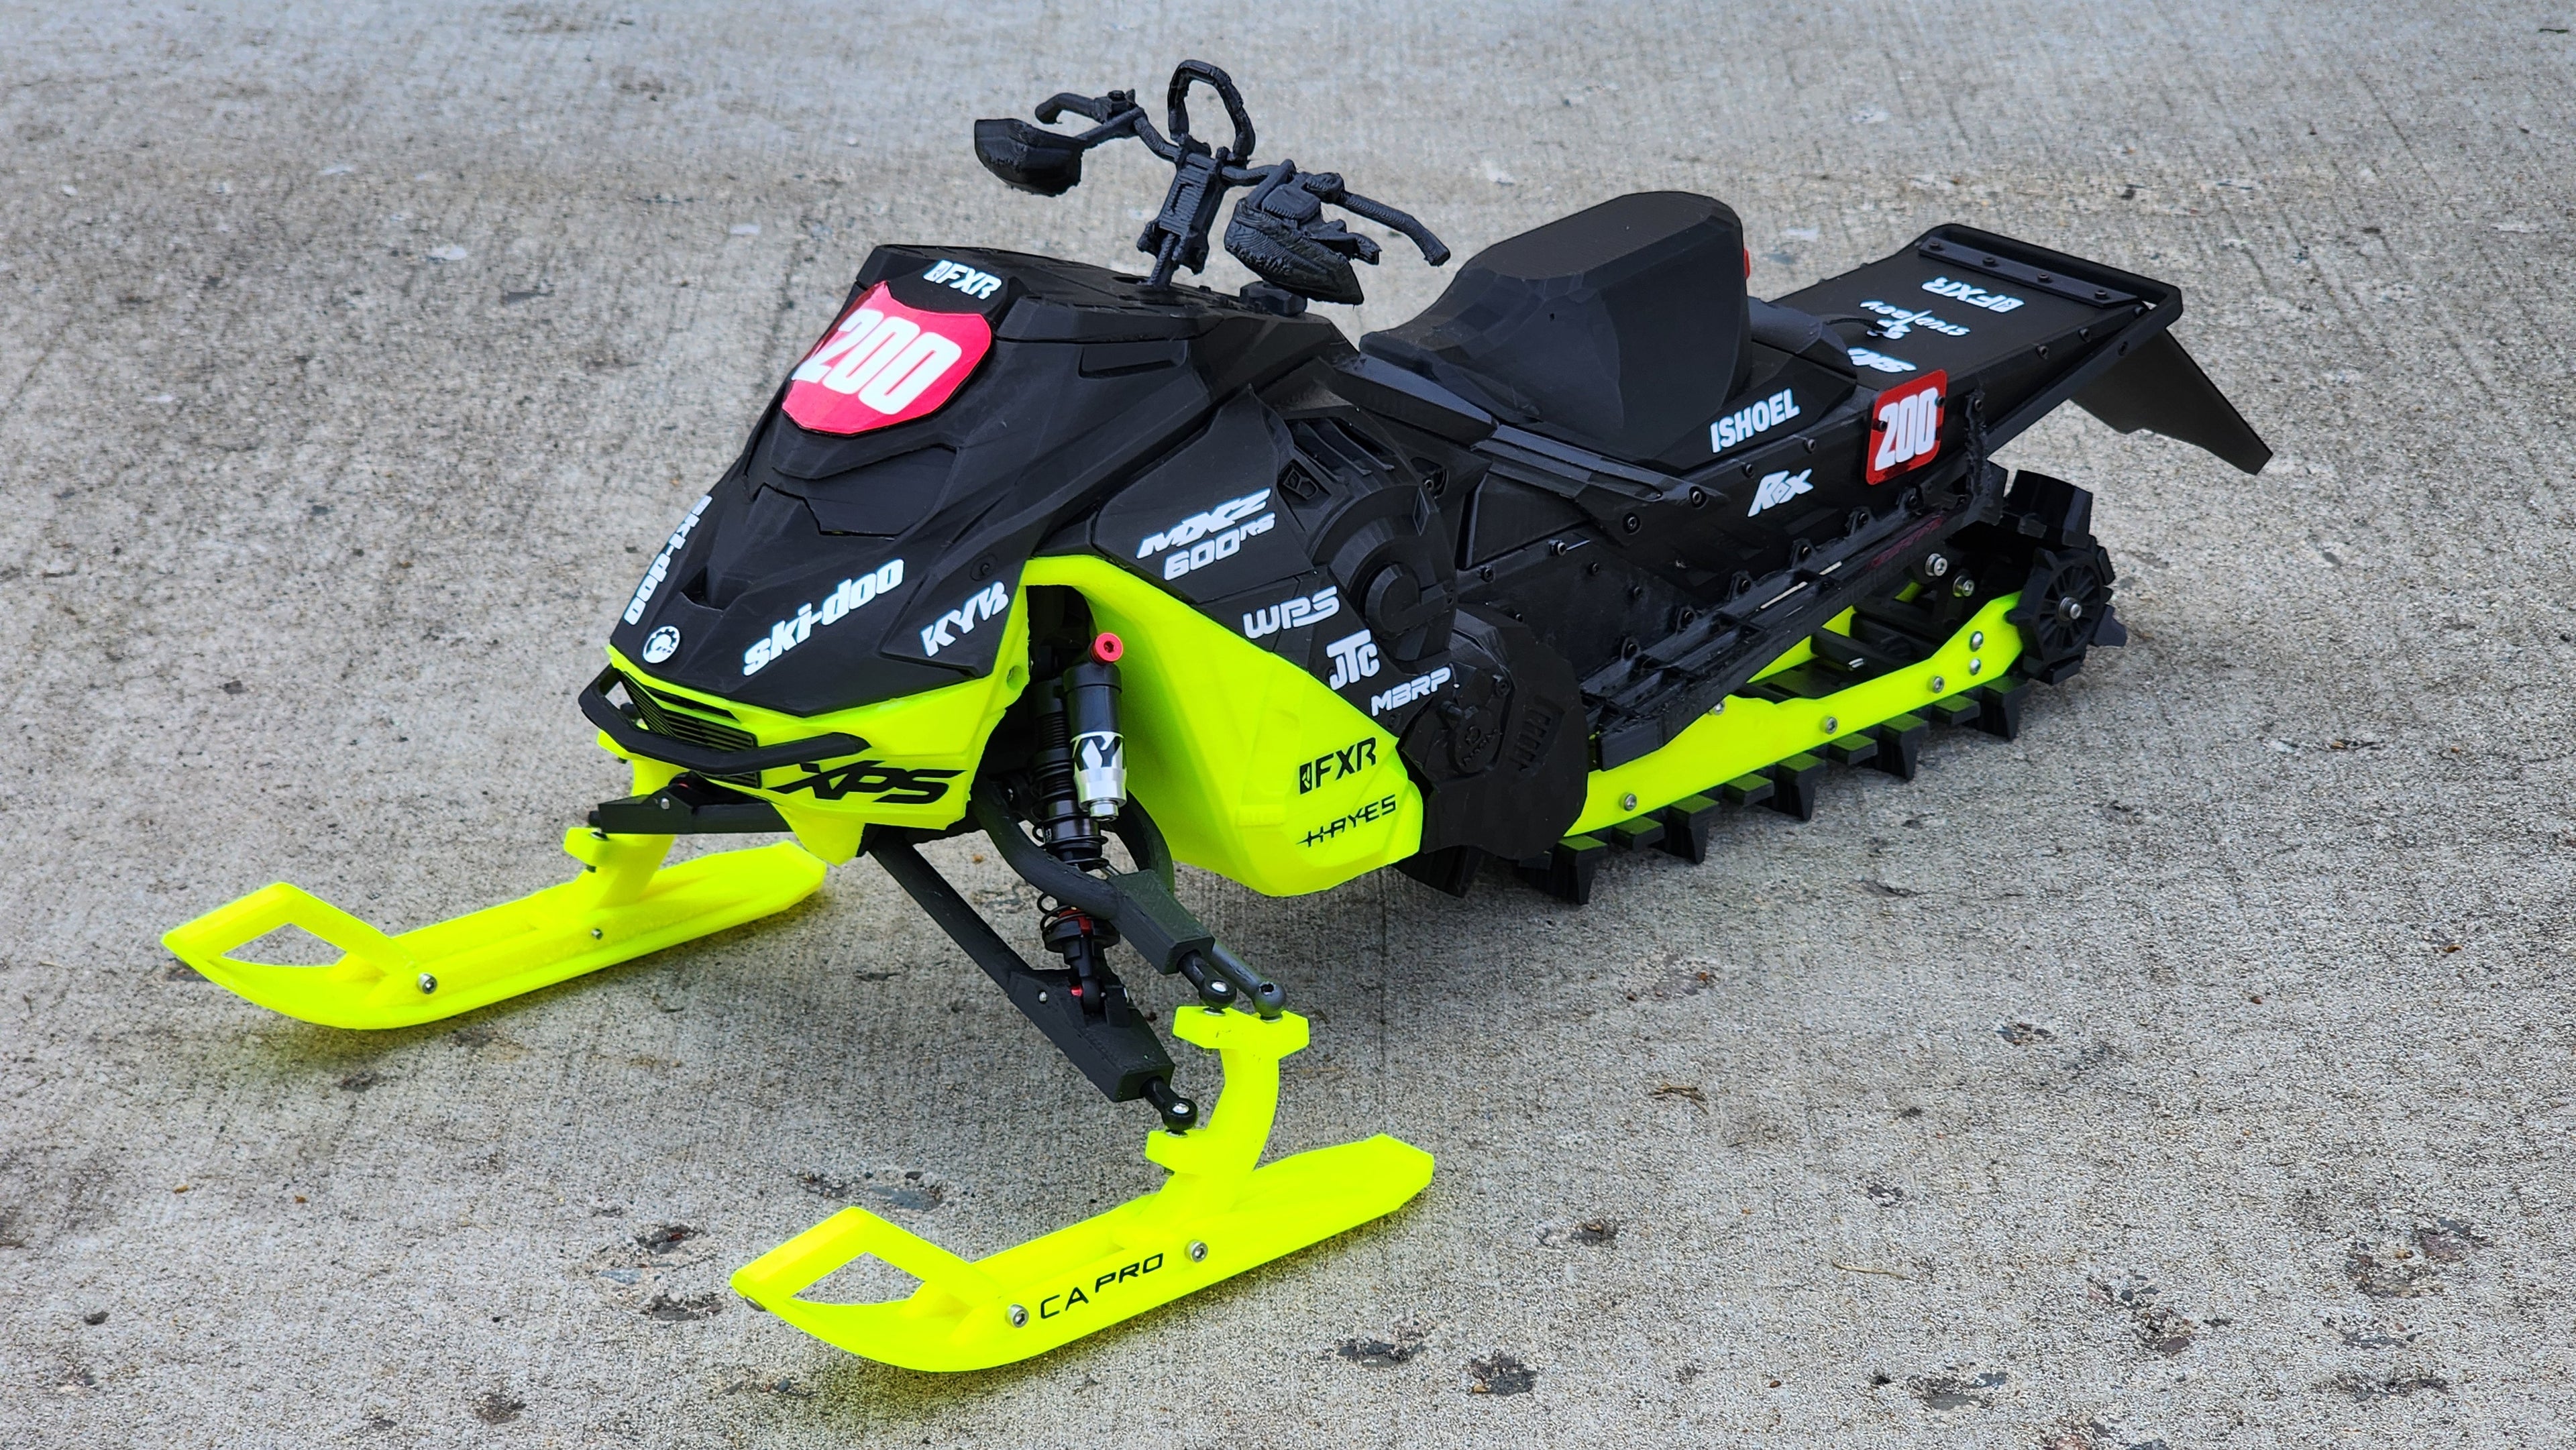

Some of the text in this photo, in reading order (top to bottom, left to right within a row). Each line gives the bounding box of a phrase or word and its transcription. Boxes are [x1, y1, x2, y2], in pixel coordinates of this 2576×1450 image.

[934, 262, 1002, 300] FXR
[1921, 276, 2006, 309] FXR
[790, 308, 962, 415] 200
[1709, 388, 1801, 454] ISHOEL
[1874, 386, 1939, 471] 200
[920, 580, 1009, 657] KYB
[1242, 585, 1340, 638] WPS
[1326, 628, 1381, 691] JTC
[1370, 666, 1452, 718] MBRP
[766, 760, 967, 805] XPS
[1315, 736, 1377, 789] FXR
[1295, 793, 1397, 848] HAYES
[1040, 1252, 1164, 1320] CA PRO
